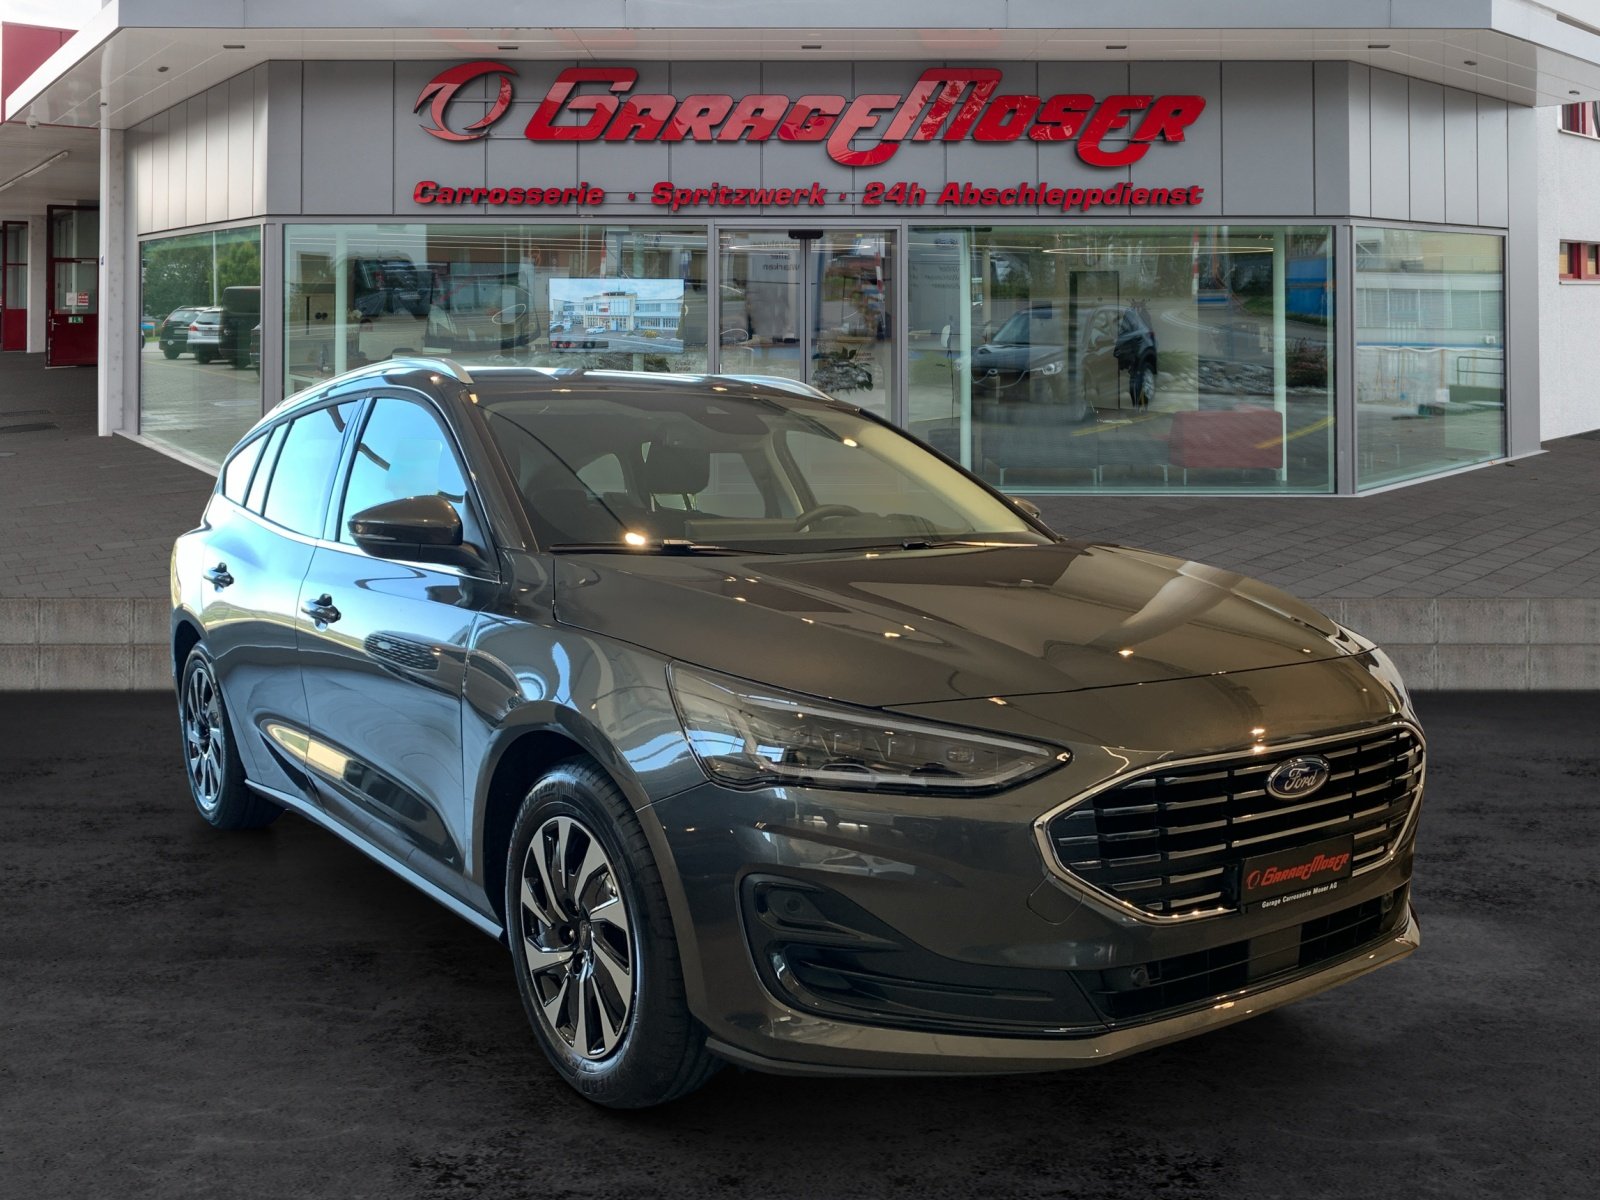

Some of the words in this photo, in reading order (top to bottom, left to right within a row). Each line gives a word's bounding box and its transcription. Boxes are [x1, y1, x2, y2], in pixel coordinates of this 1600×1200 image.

[412, 180, 606, 206] Carrosserie
[650, 181, 828, 212] Spritzwerk
[862, 181, 927, 206] 24h
[937, 181, 1204, 212] Abschleppdienst
[1284, 766, 1317, 791] Ford
[1261, 899, 1281, 909] Garage
[1312, 885, 1329, 895] Moser
[1329, 881, 1338, 890] AG
